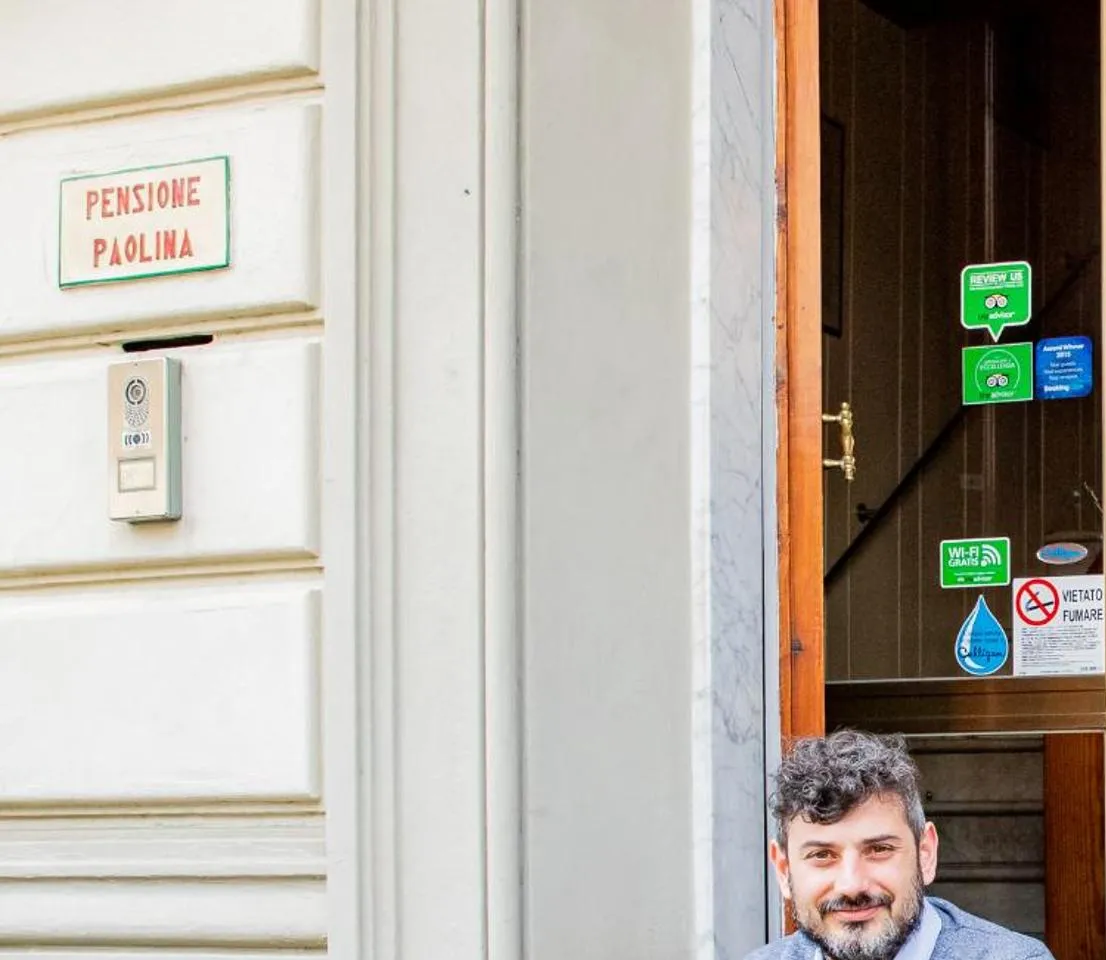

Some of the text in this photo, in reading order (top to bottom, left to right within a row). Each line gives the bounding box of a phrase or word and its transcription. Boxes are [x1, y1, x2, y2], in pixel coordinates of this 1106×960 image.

[86, 176, 201, 220] PENSIONE
[93, 228, 194, 268] PAOLINA
[970, 271, 1023, 284] REVIEW US
[948, 558, 979, 567] GRATIS
[1062, 588, 1103, 602] VIETATO
[1063, 609, 1103, 622] FUMARE
